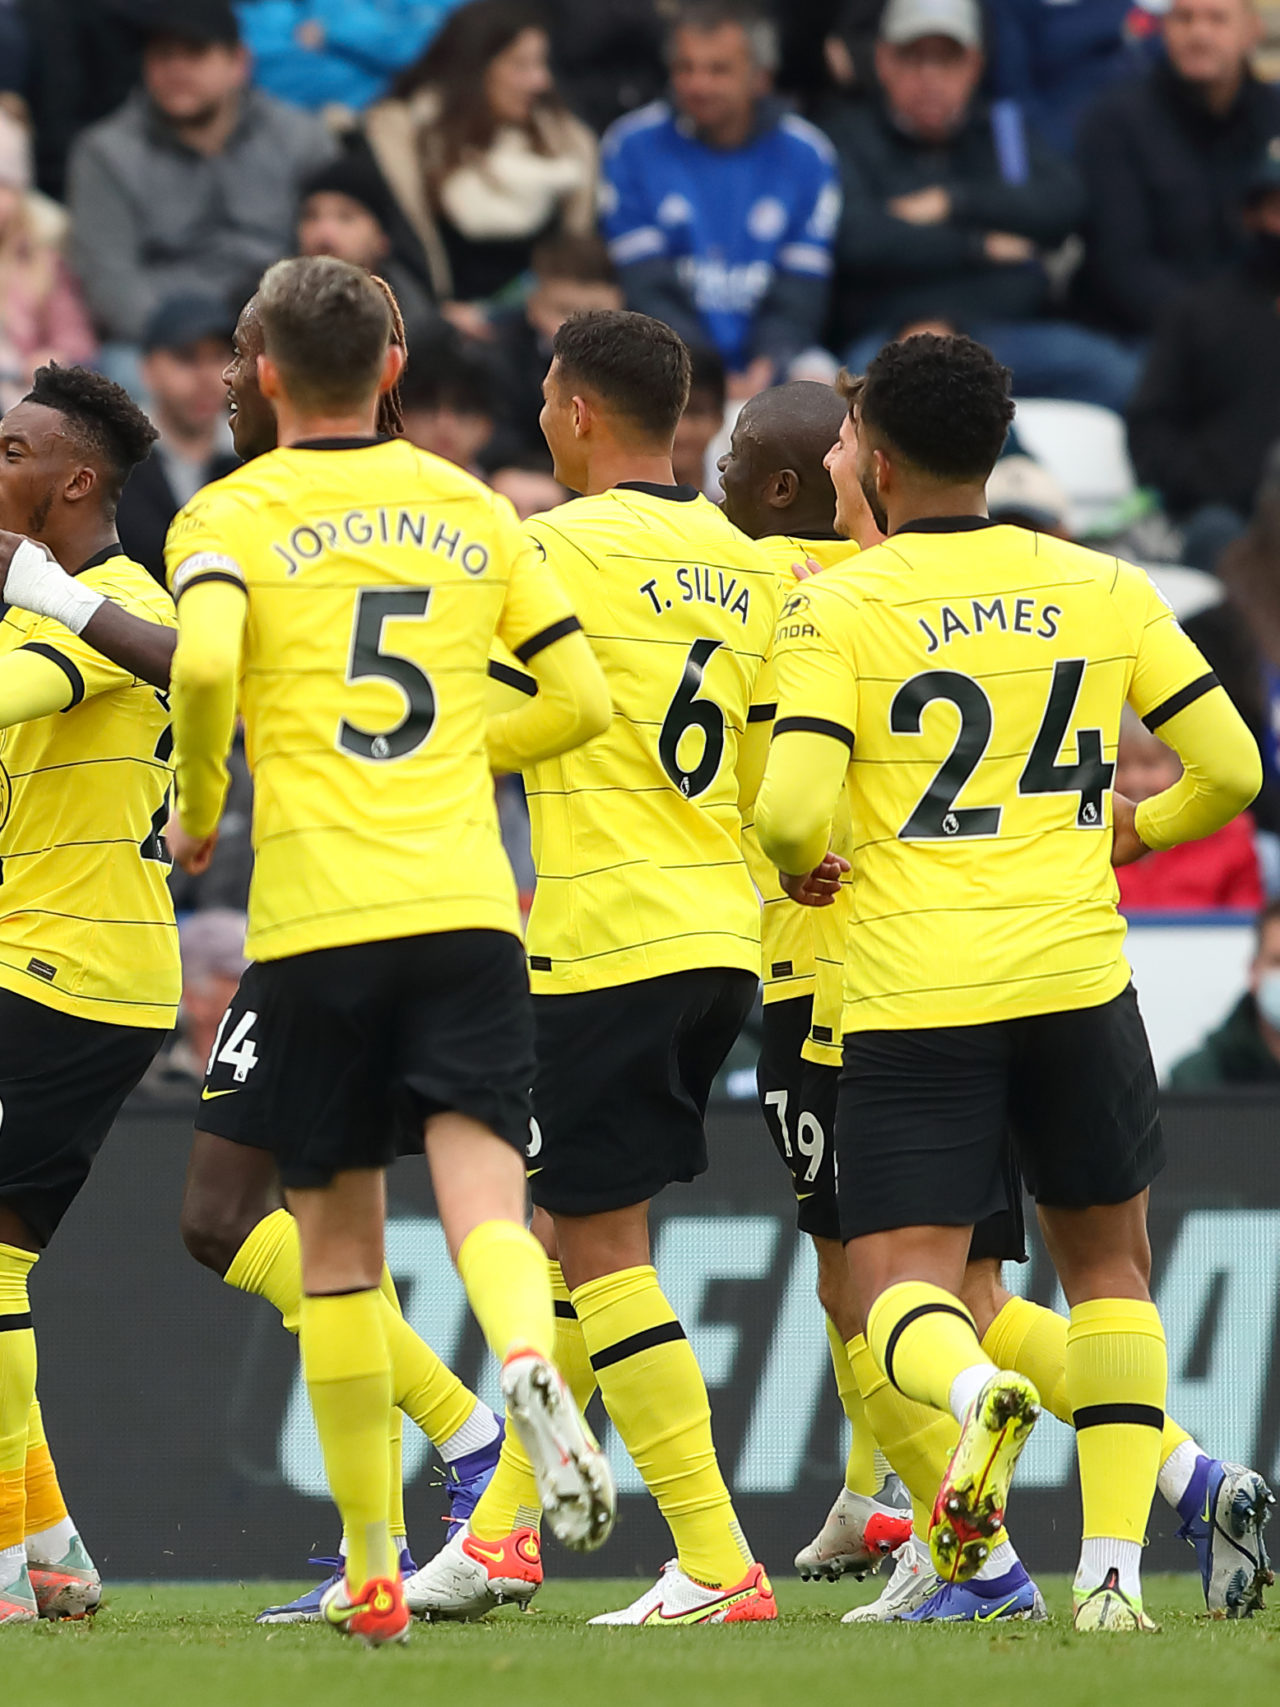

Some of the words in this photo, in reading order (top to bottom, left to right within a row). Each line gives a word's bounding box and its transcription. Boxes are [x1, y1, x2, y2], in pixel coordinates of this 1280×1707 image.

[334, 585, 439, 765] 5
[639, 578, 672, 615] T.
[676, 566, 750, 625] SILVA
[917, 597, 1063, 654] JAMES
[657, 636, 725, 801] 6
[889, 657, 1117, 842] 24
